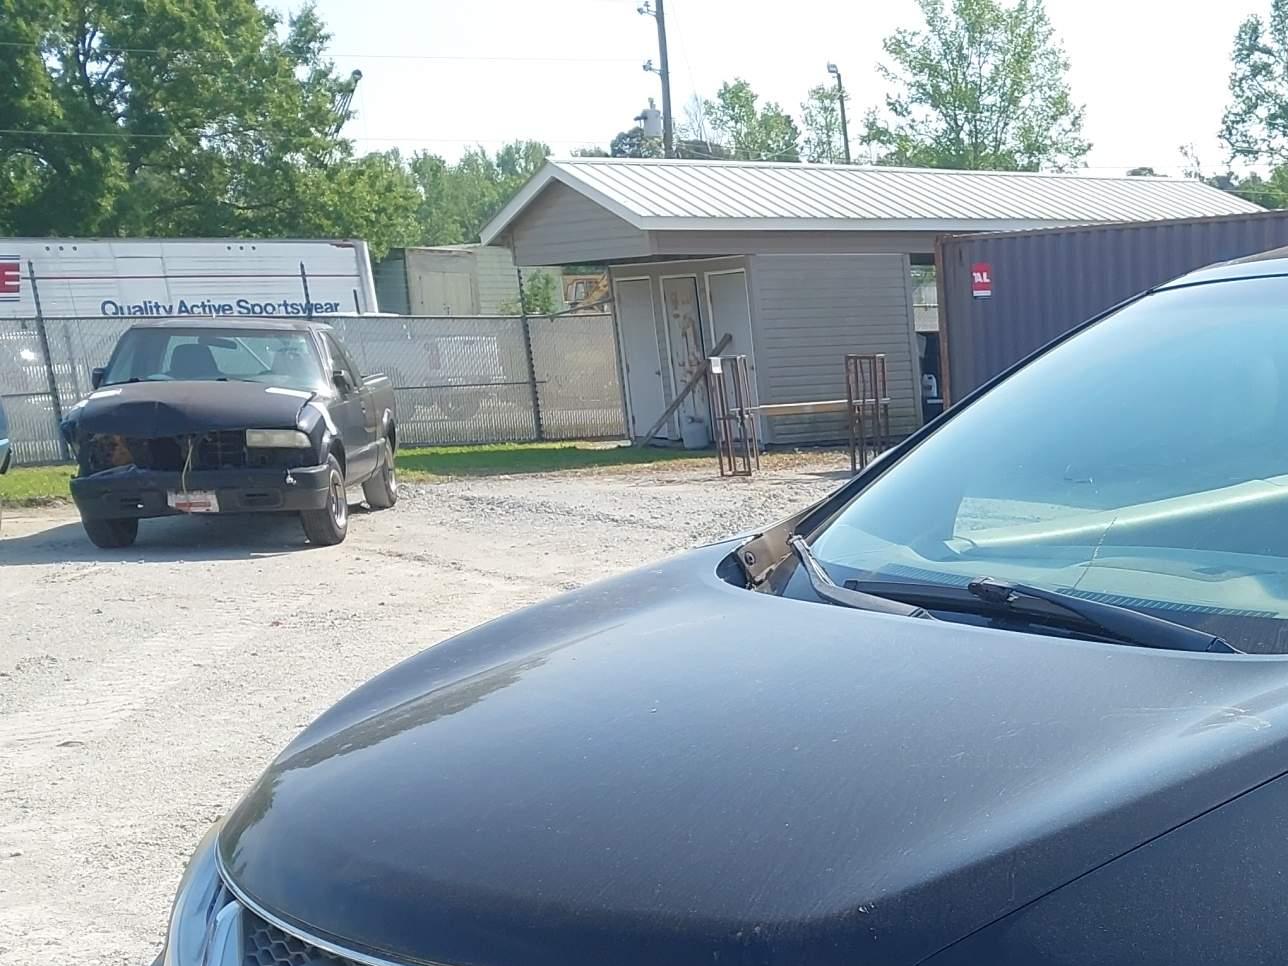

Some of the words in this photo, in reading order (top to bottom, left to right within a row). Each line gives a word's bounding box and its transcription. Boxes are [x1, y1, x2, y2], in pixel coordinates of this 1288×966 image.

[100, 299, 174, 316] Quality
[177, 299, 233, 315] Active
[236, 298, 340, 315] Sportswear
